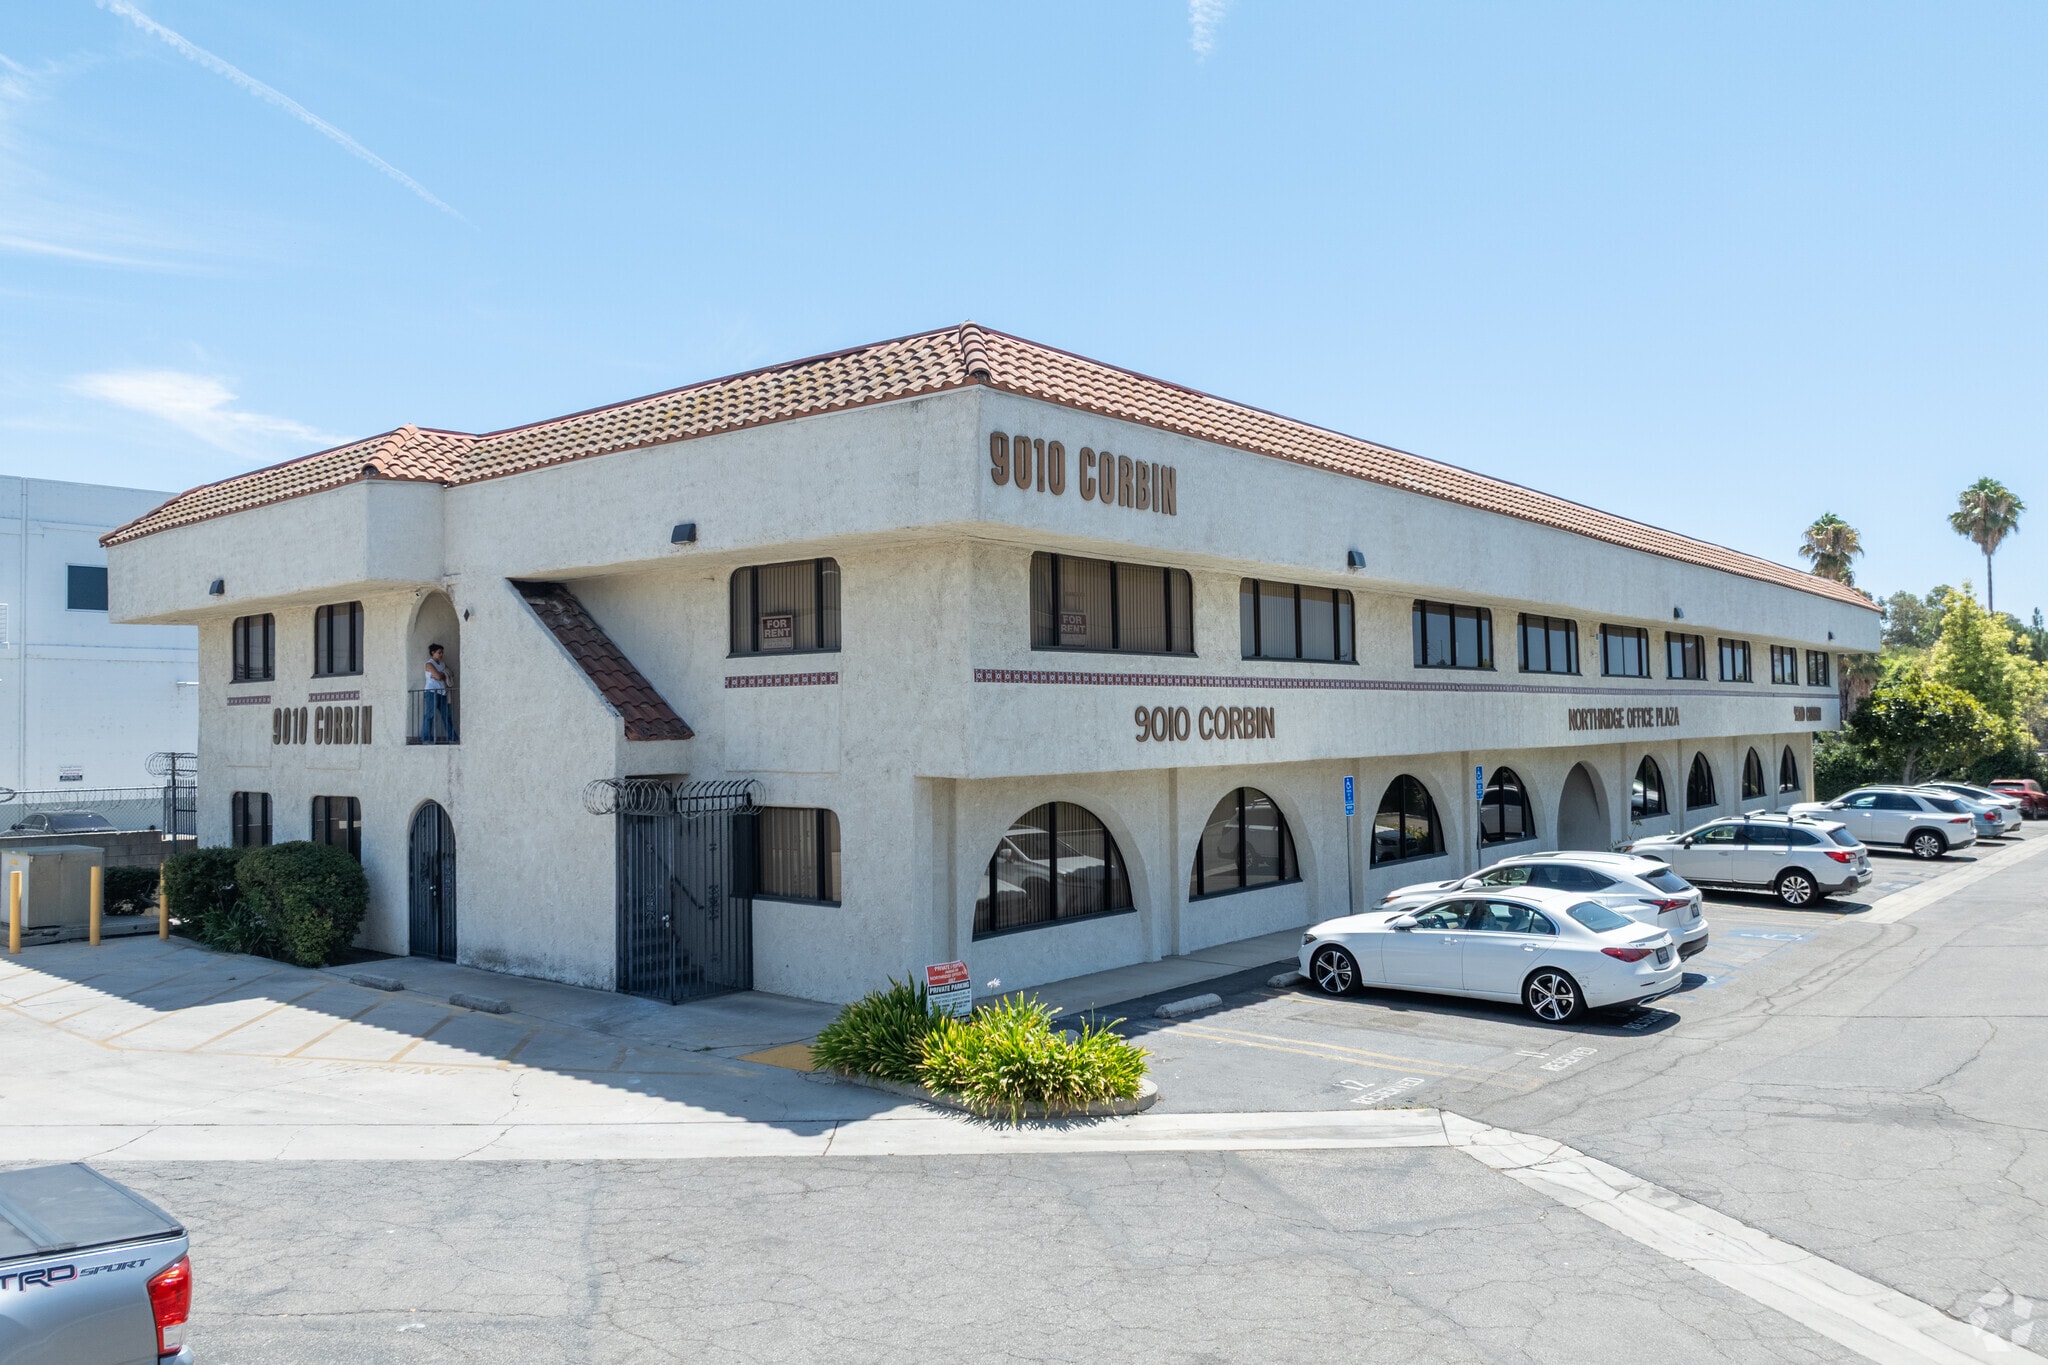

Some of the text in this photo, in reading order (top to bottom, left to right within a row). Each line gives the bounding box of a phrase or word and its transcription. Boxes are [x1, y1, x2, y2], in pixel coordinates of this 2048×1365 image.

[990, 431, 1177, 516] 9010 CORBIN
[767, 619, 787, 628] FOR
[1061, 625, 1085, 633] RENT
[1063, 615, 1082, 624] FOR
[765, 628, 790, 638] RENT
[273, 705, 373, 745] 9010 CORBIN
[1135, 706, 1275, 742] 9010 CORBIN
[1568, 706, 1680, 731] NORTHRIDGE OFFICE PLAZA
[930, 981, 970, 994] PRIVATE PARKING
[1333, 1080, 1375, 1091] 12
[1350, 1077, 1425, 1105] RESERVED
[0, 1258, 151, 1292] TRD SPORT
